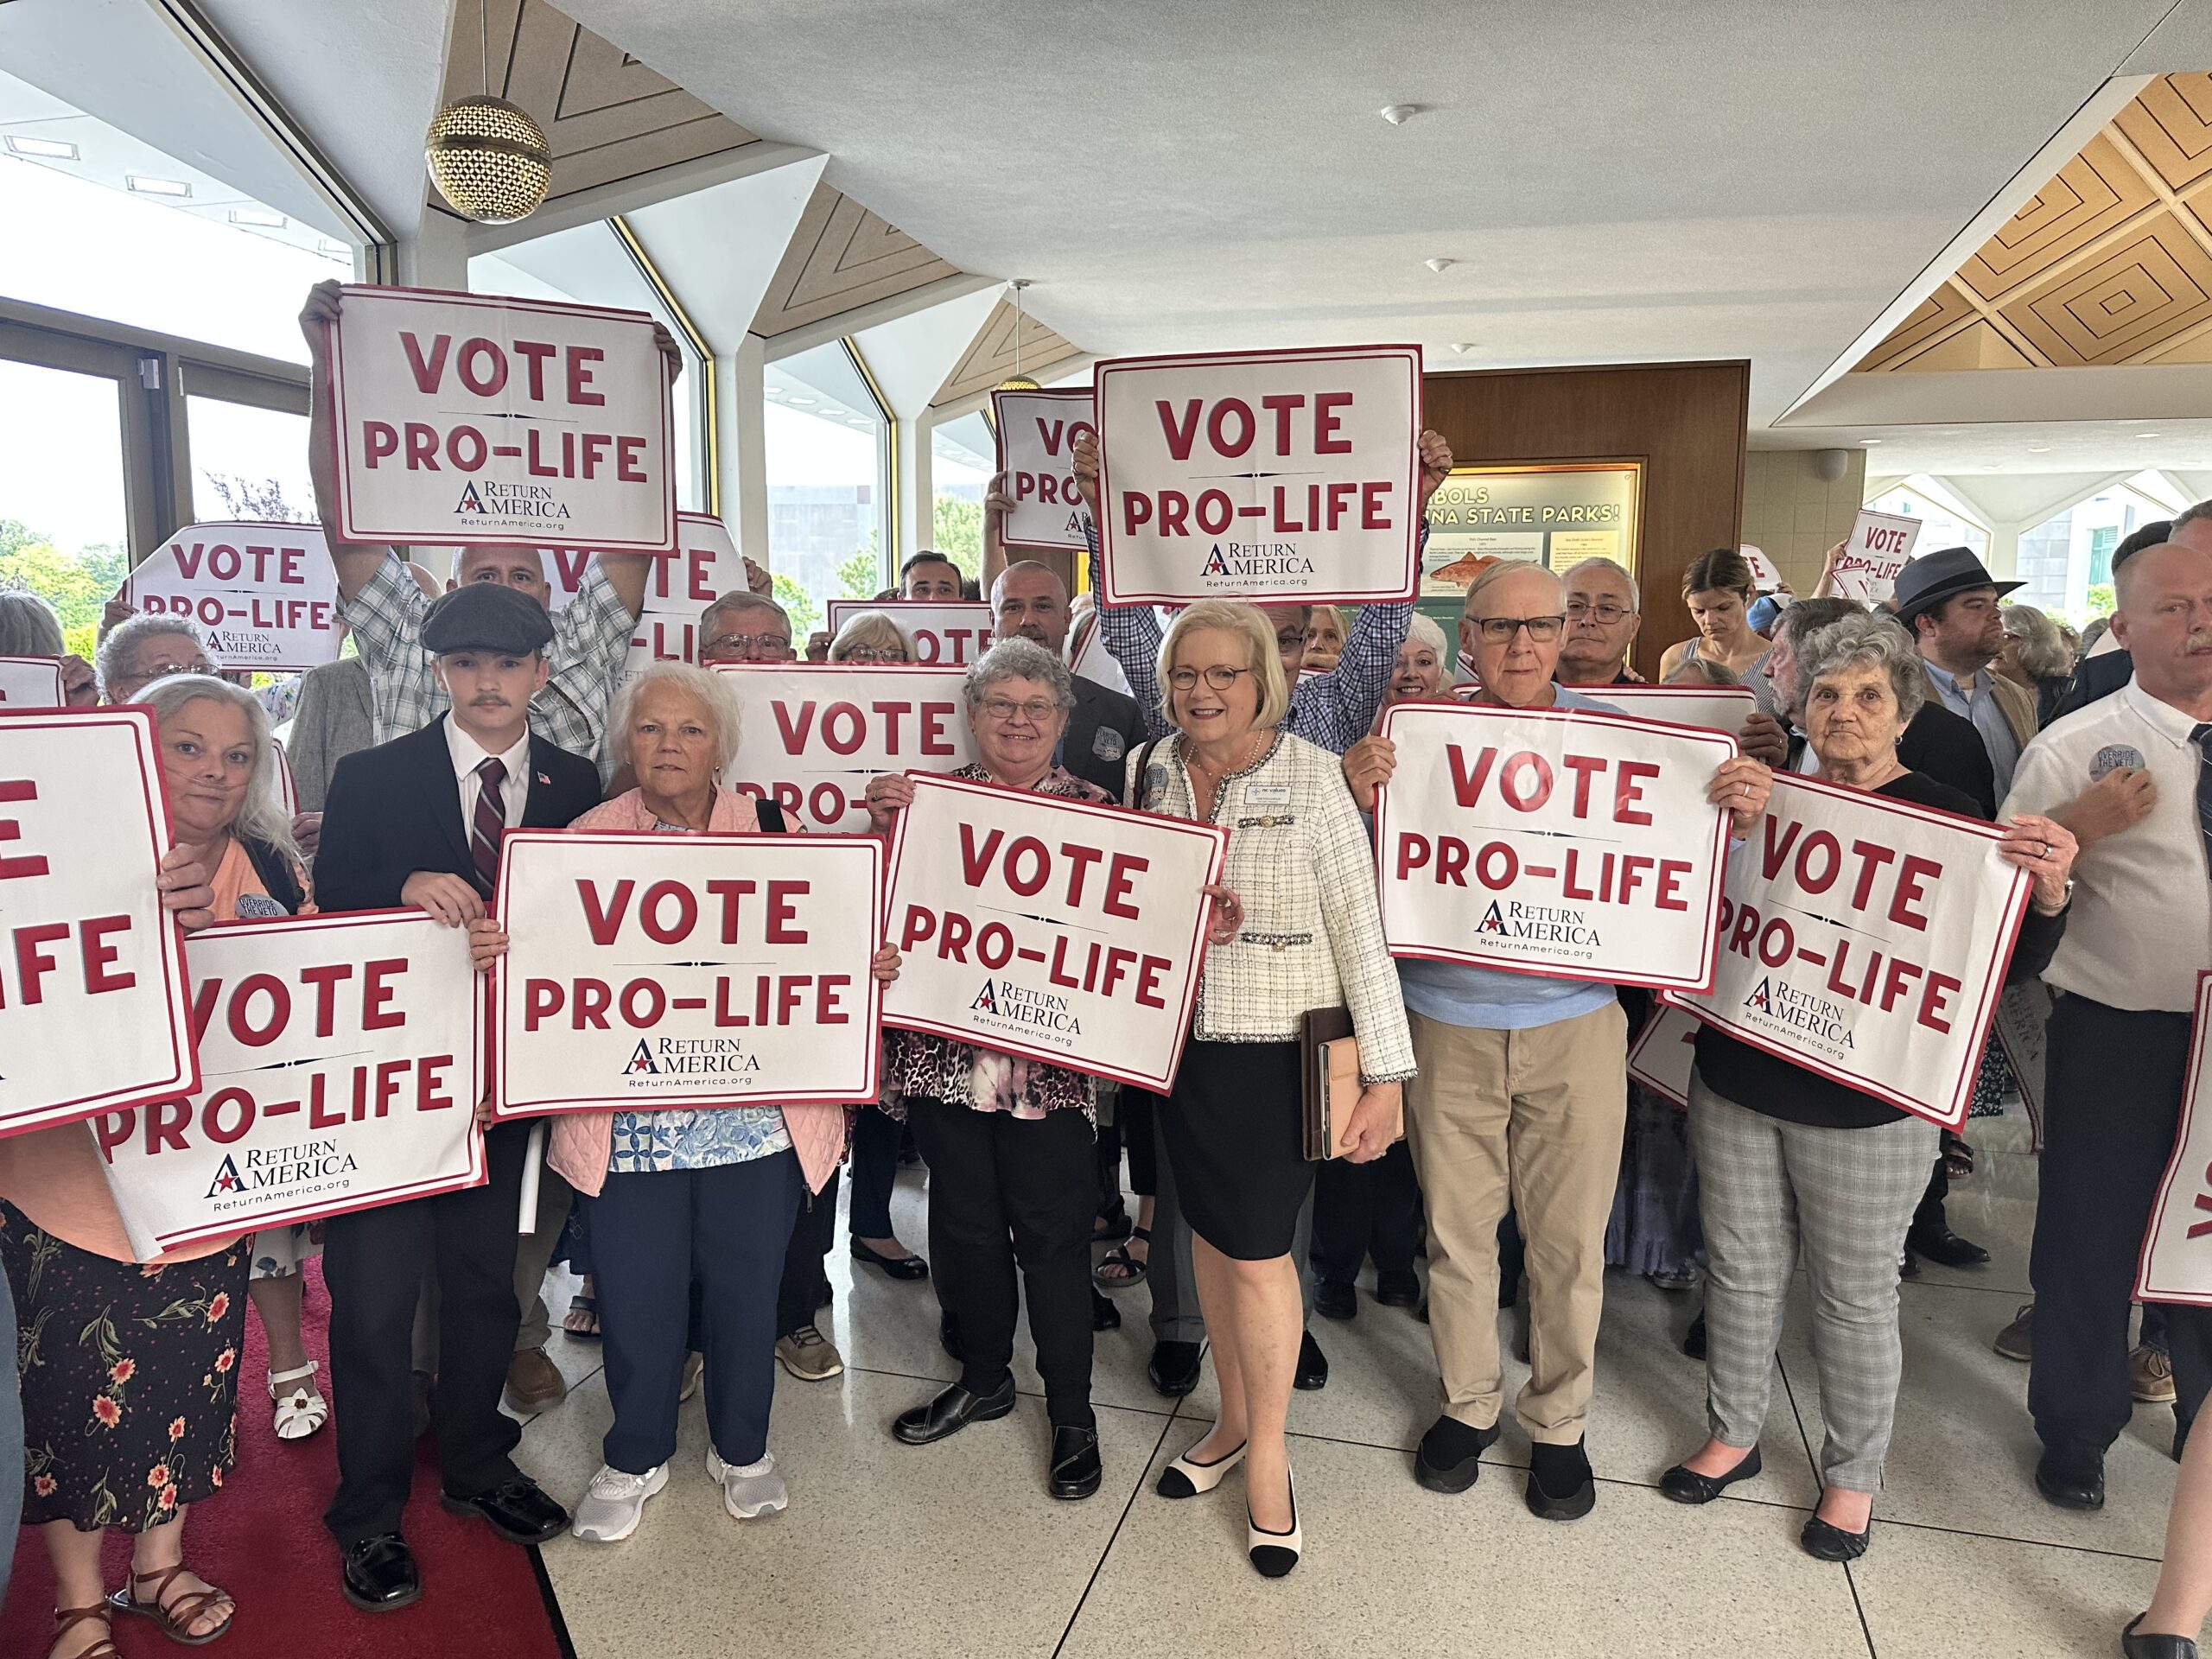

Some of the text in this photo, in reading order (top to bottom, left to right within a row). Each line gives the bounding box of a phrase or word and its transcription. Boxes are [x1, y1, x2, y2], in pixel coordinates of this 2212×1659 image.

[399, 331, 605, 406] VOTE
[1155, 391, 1353, 461] VOTE
[363, 421, 647, 483] PRO-LIFE
[453, 480, 572, 518] AMERICA
[484, 480, 552, 499] RETURN
[1122, 480, 1393, 537] PRO-LIFE
[1427, 487, 1489, 505] BOLS
[461, 518, 564, 531] ReturnAmerica.org
[1466, 506, 1534, 524] STATE
[1541, 505, 1620, 523] PARKS!
[1230, 542, 1296, 557] RETURN
[1866, 526, 1907, 553] VOTE
[171, 543, 305, 584] VOTE
[1199, 542, 1314, 577] AMERICA
[1206, 578, 1307, 588] ReturnAmerica.org
[222, 631, 270, 642] RETURN
[770, 701, 955, 755] VOTE
[2098, 750, 2134, 760] OVERRIDE
[1446, 743, 1661, 827] VOTE
[958, 822, 1149, 920] VOTE
[1396, 831, 1693, 912] PRO-LIFE
[1761, 813, 1943, 932] VOTE
[239, 898, 274, 908] OVERRIDE
[243, 906, 277, 916] THE VETO
[575, 879, 810, 945] VOTE
[1510, 900, 1586, 925] RETURN
[1474, 899, 1602, 947] AMERICA
[900, 904, 1172, 1009] PRO-LIFE
[1480, 938, 1593, 959] ReturnAmerica.org
[524, 975, 851, 1032] PRO-LIFE
[969, 977, 1082, 1035] AMERICA
[1001, 981, 1069, 1012] RETURN
[1743, 975, 1856, 1050] AMERICA
[1776, 980, 1846, 1022] RETURN
[658, 1037, 741, 1054] RETURN
[973, 1015, 1072, 1047] ReturnAmerica.org
[1745, 1011, 1846, 1061] ReturnAmerica.org
[621, 1037, 760, 1075] AMERICA
[629, 1076, 752, 1088] ReturnAmerica.org
[92, 1054, 453, 1164] PRO-LIFE
[245, 1139, 338, 1169] RETURN
[204, 1153, 358, 1198] AMERICA
[213, 1179, 350, 1211] ReturnAmerica.org
